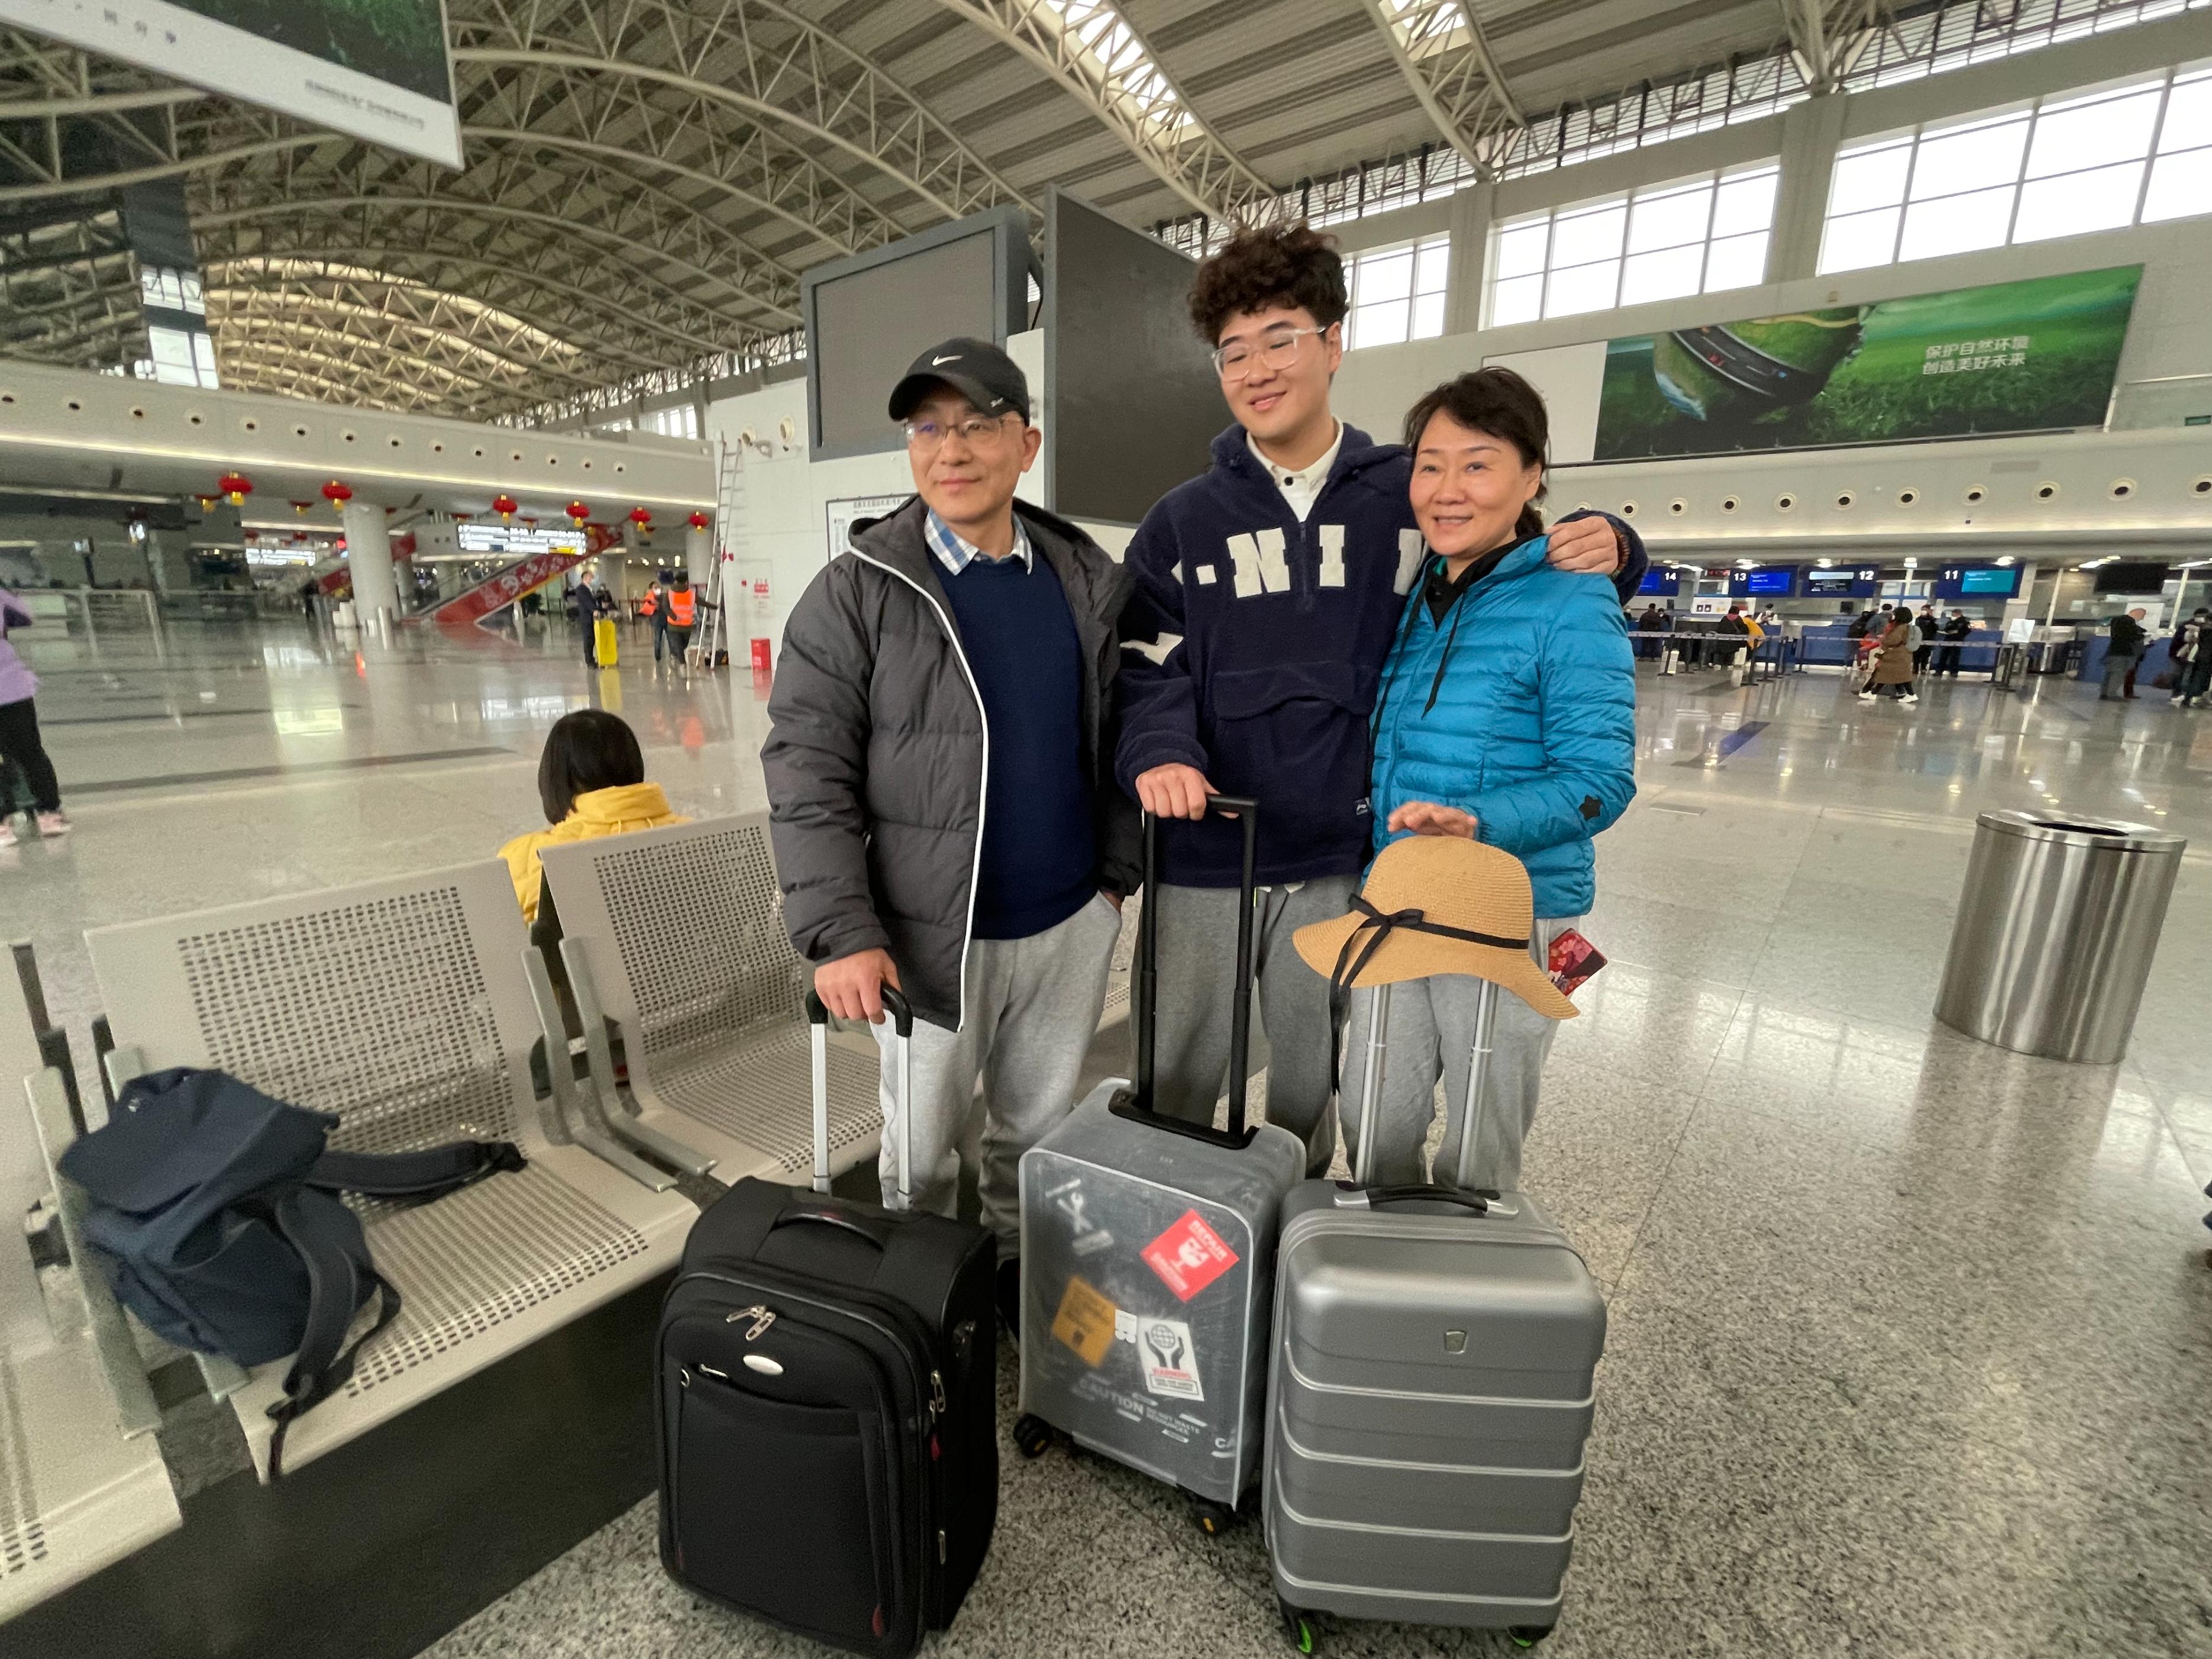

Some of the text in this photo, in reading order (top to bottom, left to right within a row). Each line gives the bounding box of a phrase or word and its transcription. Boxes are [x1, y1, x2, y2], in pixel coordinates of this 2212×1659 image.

[1664, 572, 1677, 581] 14
[1734, 572, 1747, 581] 13
[1859, 570, 1875, 580] 12
[1944, 570, 1958, 580] 11
